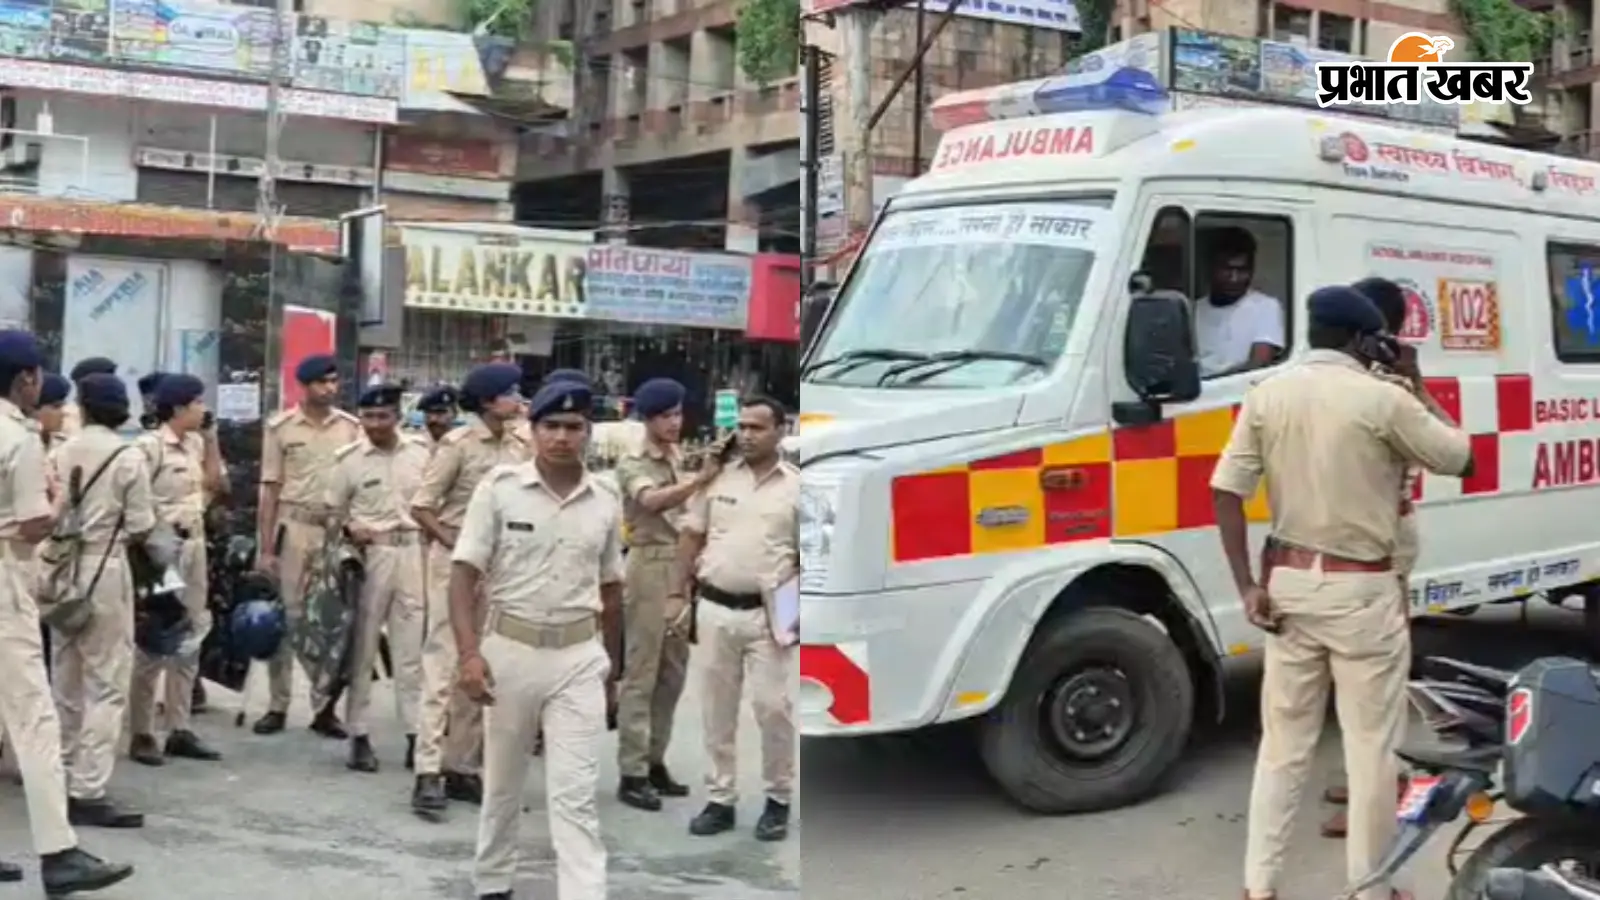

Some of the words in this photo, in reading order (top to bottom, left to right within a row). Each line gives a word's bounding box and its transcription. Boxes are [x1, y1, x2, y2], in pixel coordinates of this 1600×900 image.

[404, 244, 586, 303] ALANKAR
[1450, 287, 1486, 330] 102
[1535, 398, 1588, 423] BASIC
[1531, 437, 1600, 489] AMB
